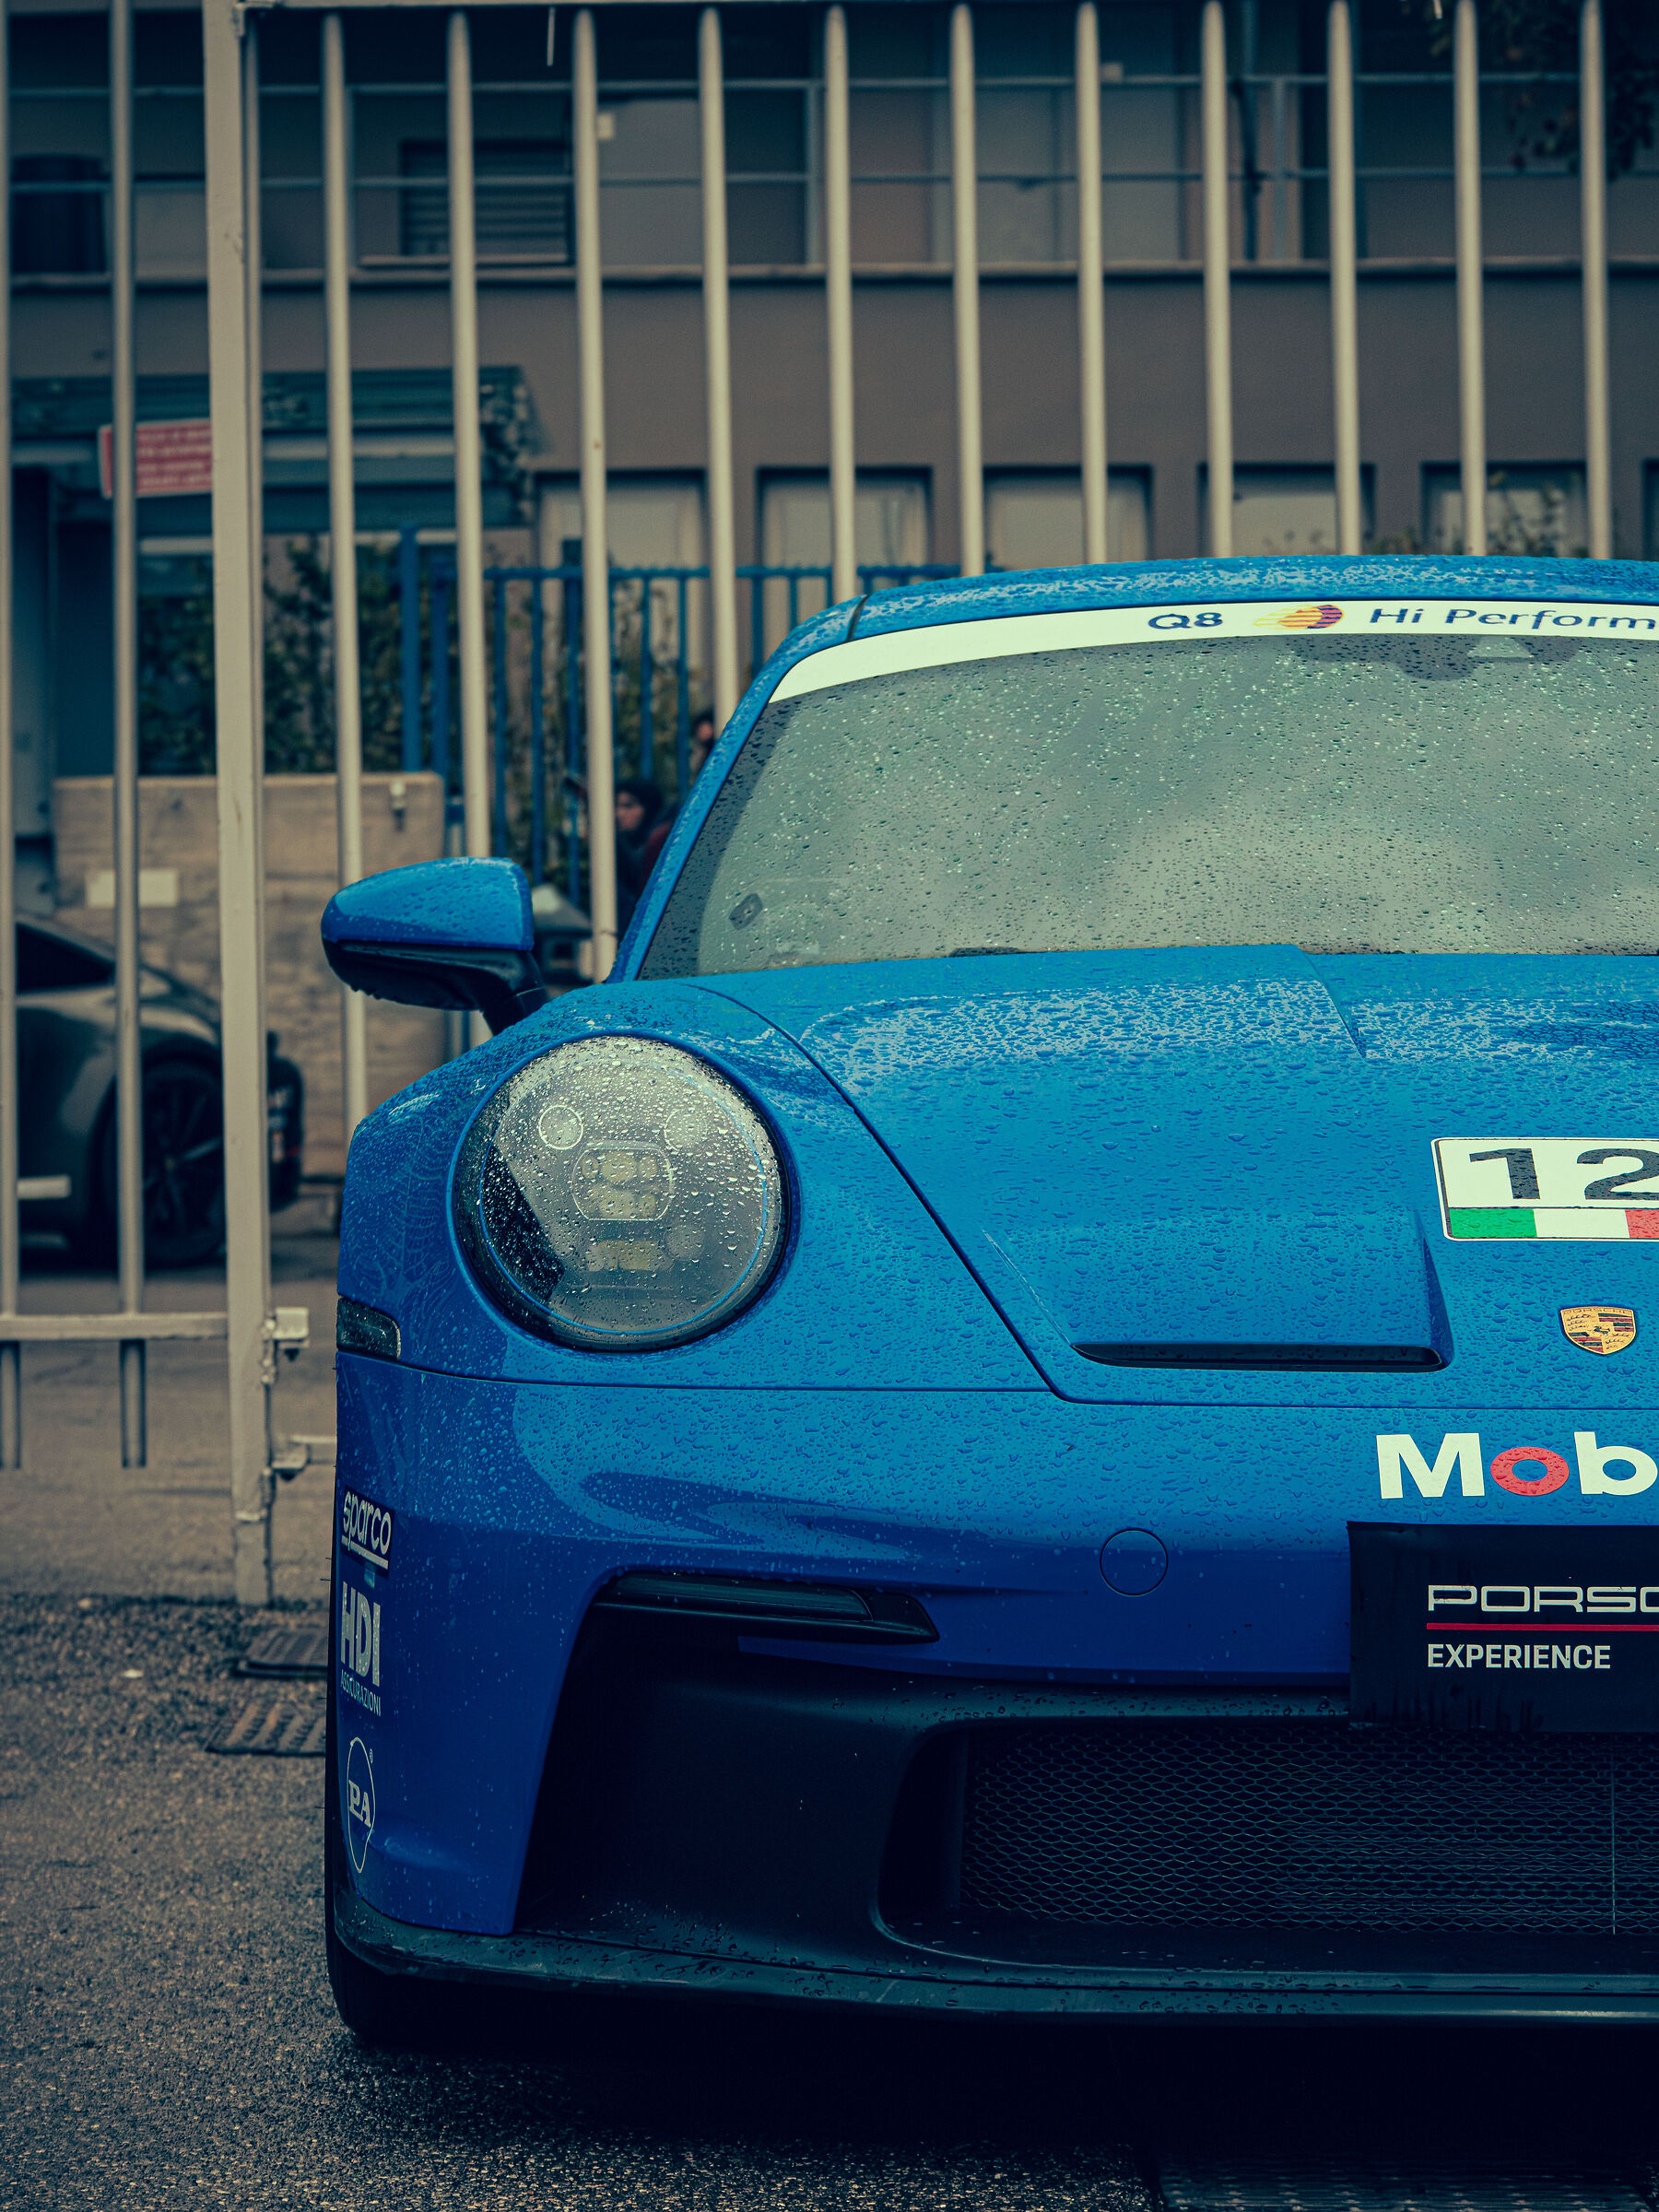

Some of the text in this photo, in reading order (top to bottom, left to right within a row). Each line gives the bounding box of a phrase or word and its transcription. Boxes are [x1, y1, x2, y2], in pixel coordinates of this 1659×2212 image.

[1147, 608, 1656, 629] Q8 Hi Perform
[1469, 1147, 1659, 1200] 12
[1376, 1431, 1658, 1499] Mob
[343, 1490, 392, 1555] sparco
[340, 1581, 381, 1687] HDI
[1428, 1643, 1611, 1669] EXPERIENCE
[340, 1669, 382, 1717] ASSICURAZIONI
